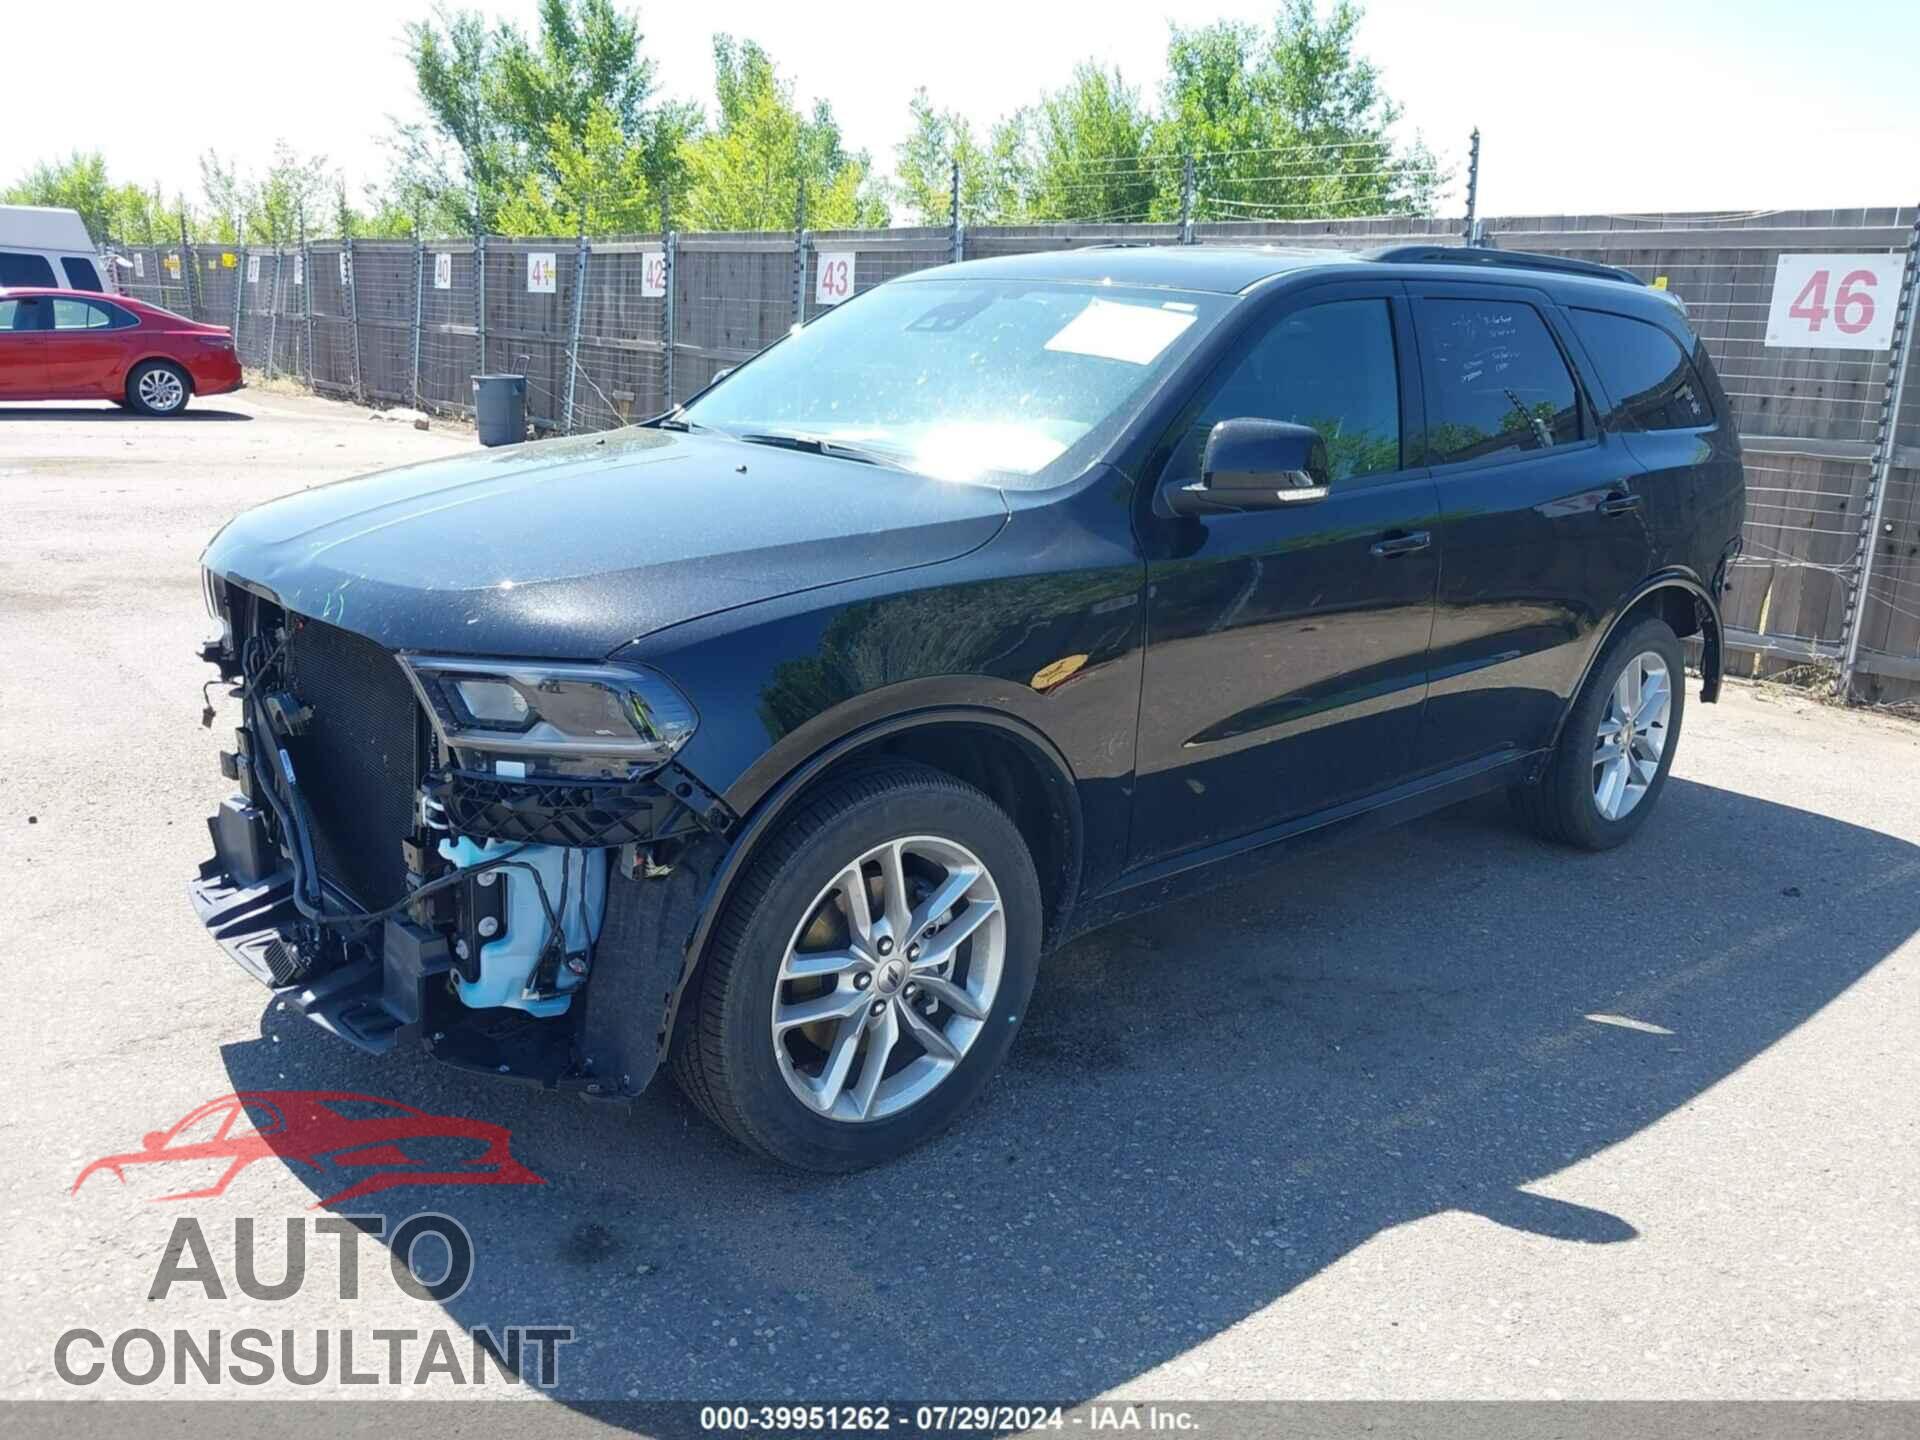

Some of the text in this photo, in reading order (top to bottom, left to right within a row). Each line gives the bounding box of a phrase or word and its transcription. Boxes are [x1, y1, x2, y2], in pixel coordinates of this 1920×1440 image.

[646, 260, 663, 288] 42
[822, 260, 848, 296] 43
[1789, 270, 1877, 334] 46
